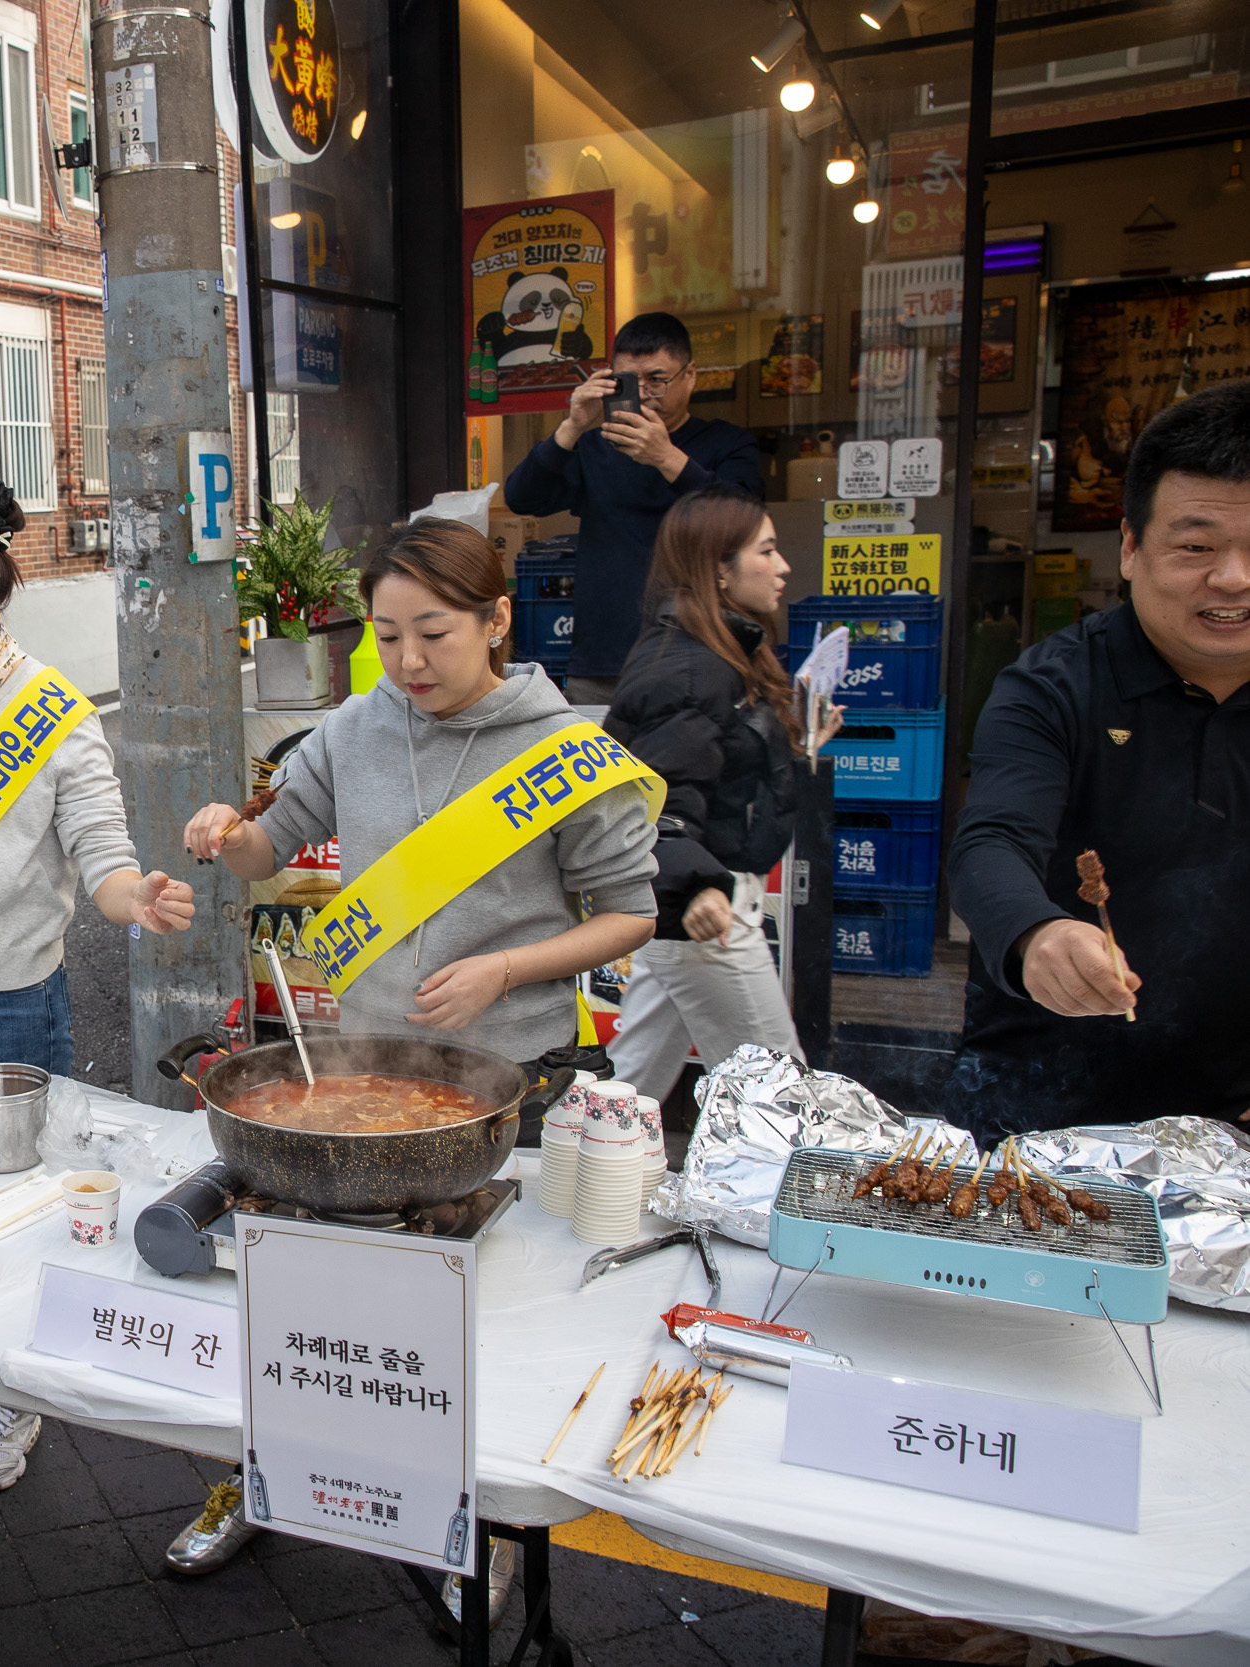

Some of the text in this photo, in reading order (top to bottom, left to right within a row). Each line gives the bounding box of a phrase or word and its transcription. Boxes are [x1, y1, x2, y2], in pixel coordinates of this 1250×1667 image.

[306, 210, 327, 288] P
[492, 229, 523, 249] 건대
[471, 242, 607, 277] 무조건 칭따오지!
[299, 306, 336, 339] PARKING
[198, 453, 232, 539] P
[831, 543, 908, 559] 新人注册
[830, 560, 908, 576] 立领红包
[834, 755, 901, 773] 이트진로
[838, 839, 876, 857] 처음
[838, 855, 876, 872] 처럼
[836, 928, 870, 944] 처음
[836, 941, 873, 955] 처럼
[93, 1307, 222, 1369] 별빛의 잔
[286, 1332, 425, 1376] 차례대로 줄을
[262, 1361, 452, 1416] 서 주시길 바랍니다
[887, 1415, 1017, 1474] 준하네
[309, 1473, 402, 1500] 중국 4대명주 노주노교
